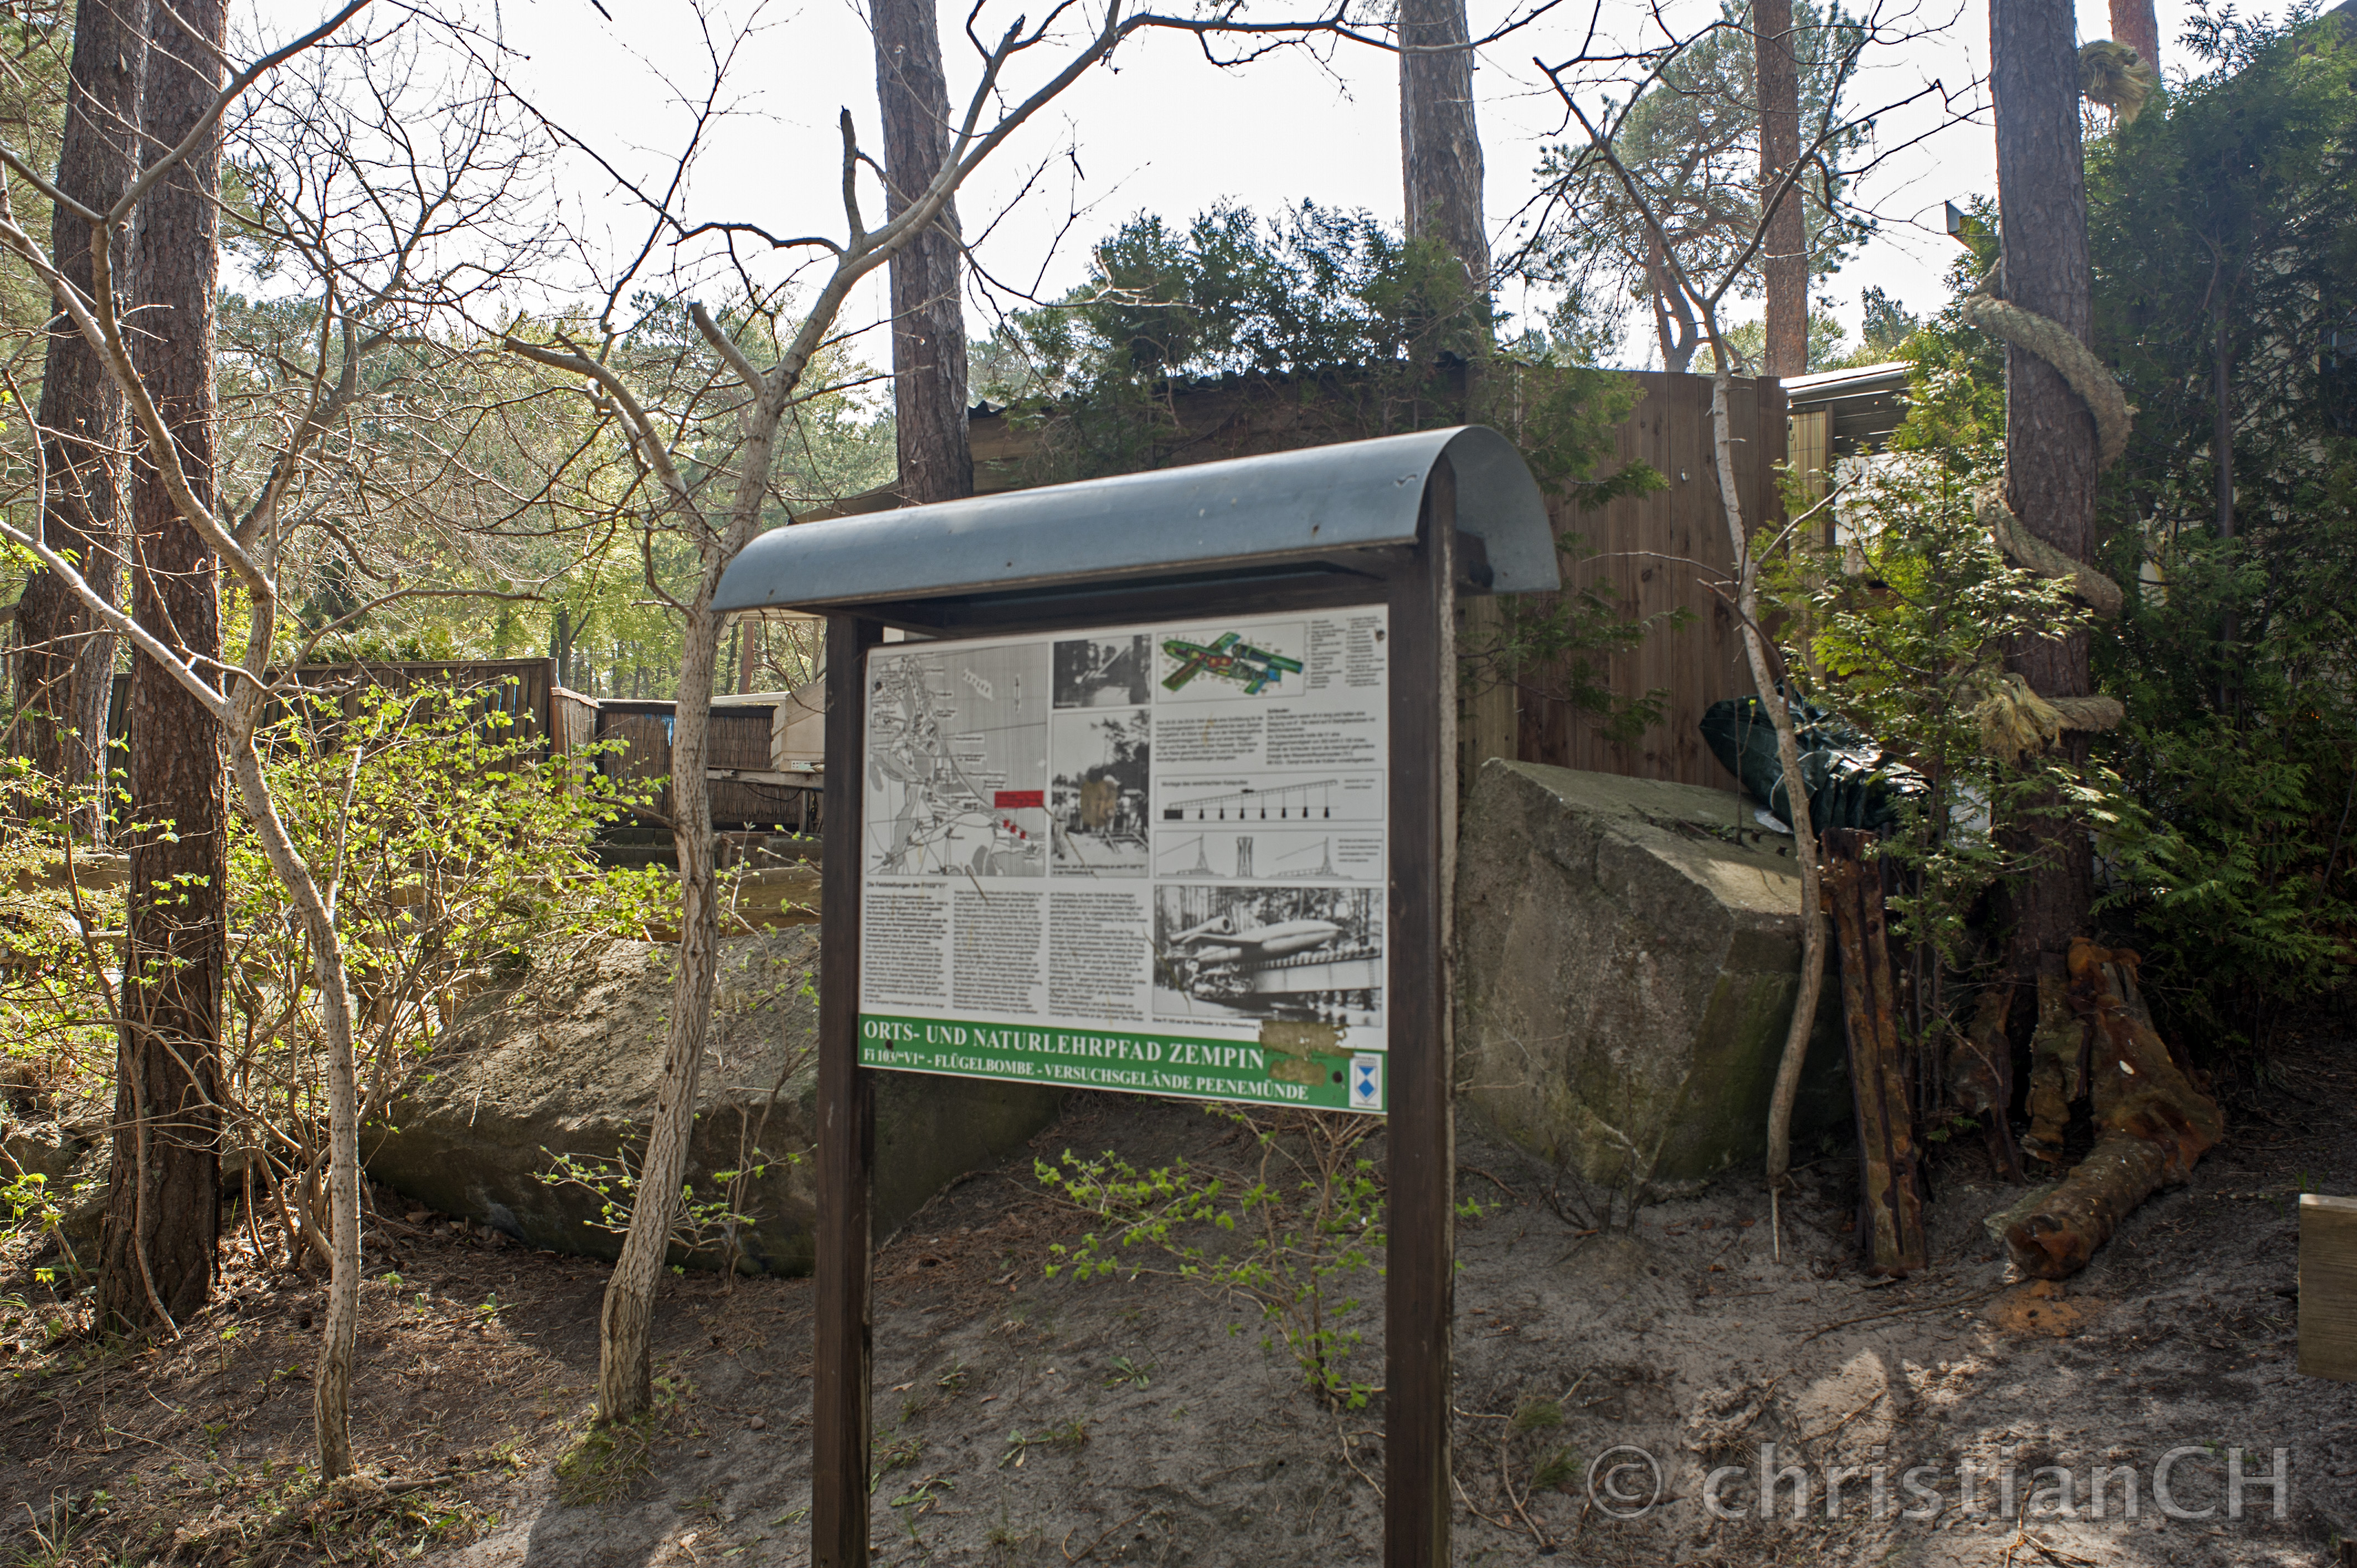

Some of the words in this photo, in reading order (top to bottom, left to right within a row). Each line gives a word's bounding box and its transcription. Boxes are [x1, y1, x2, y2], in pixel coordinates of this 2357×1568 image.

[864, 1020, 920, 1041] ORTS-
[927, 1025, 967, 1045] UND
[973, 1028, 1162, 1061] NATURLEHRPFAD
[1169, 1043, 1264, 1070] ZEMPIN
[864, 1048, 875, 1061] Fi
[934, 1053, 1035, 1076] FLÜGELBOMBE
[1044, 1064, 1192, 1090] VERSUCHSGELÄNDE
[1196, 1073, 1309, 1101] PEENEMÜNDE
